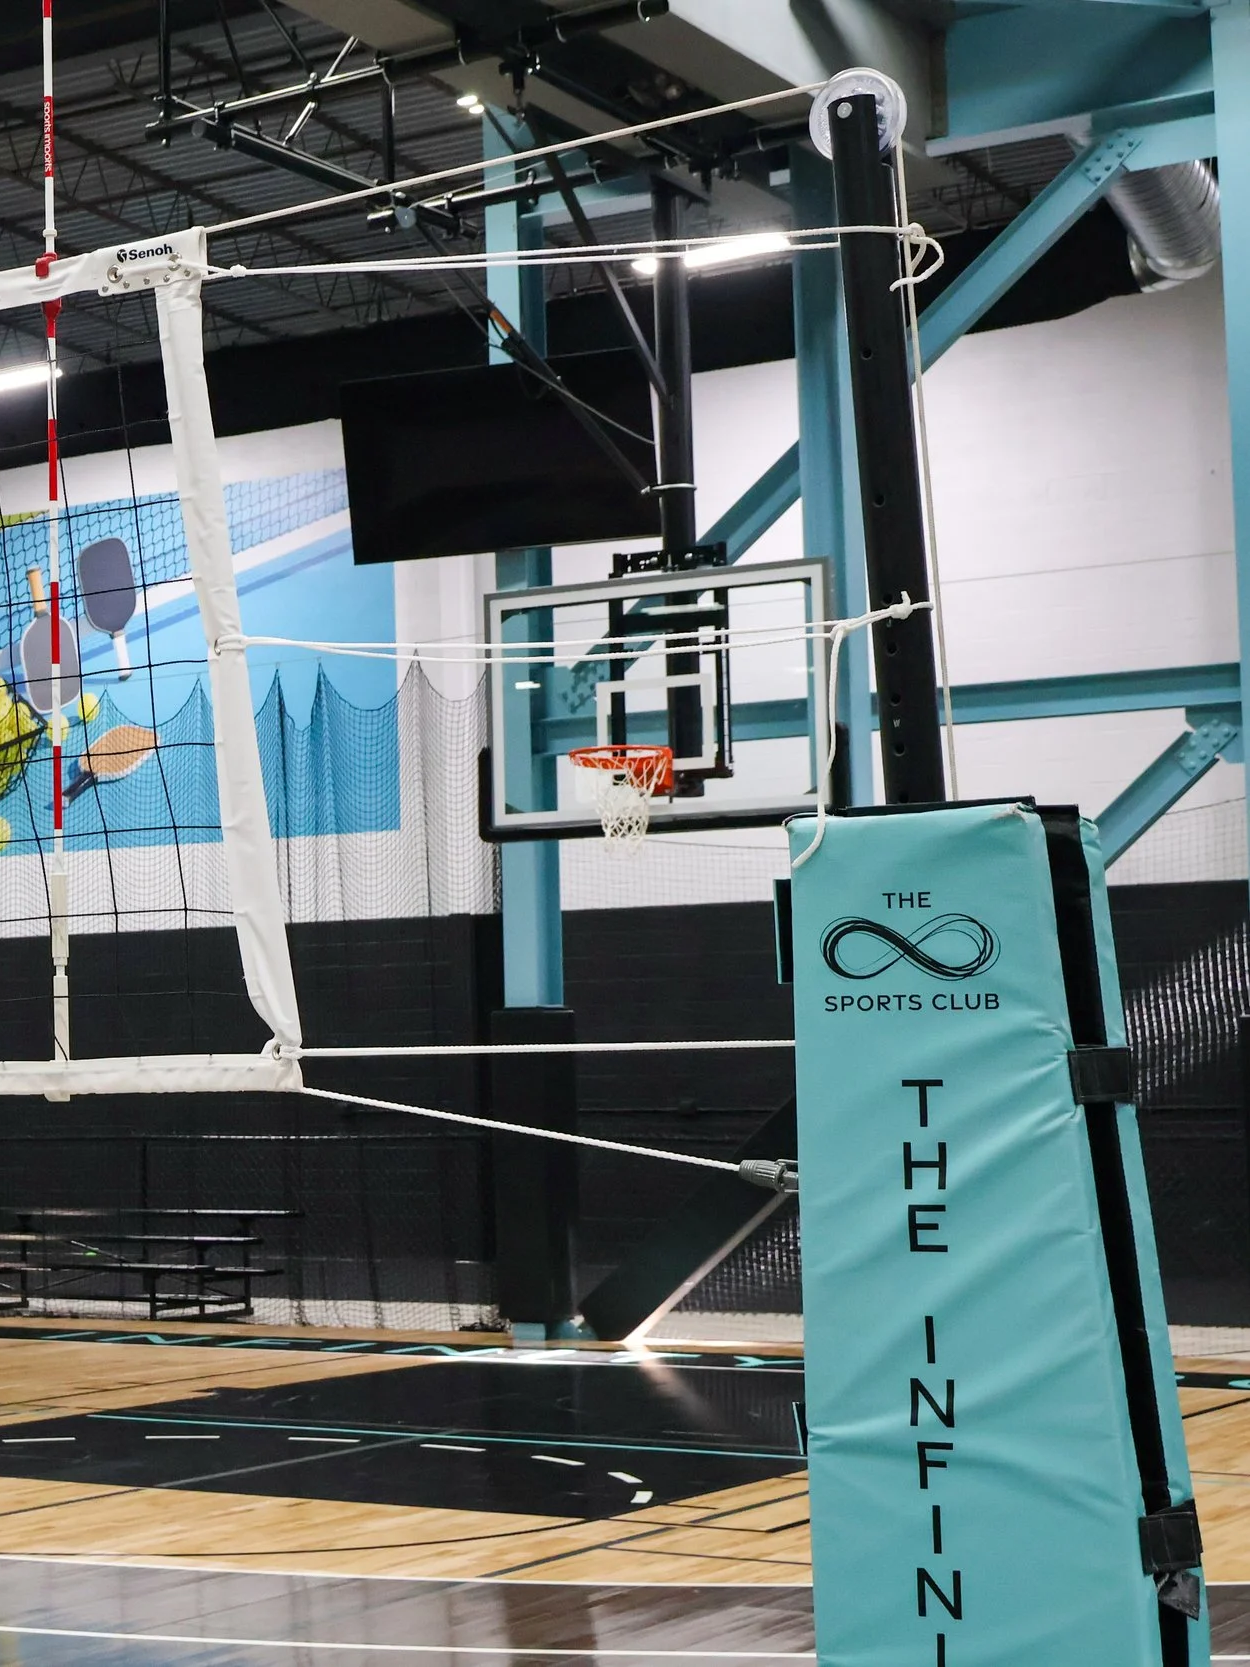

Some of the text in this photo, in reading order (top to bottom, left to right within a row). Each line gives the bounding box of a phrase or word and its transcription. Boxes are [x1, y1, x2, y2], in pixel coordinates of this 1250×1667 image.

[129, 243, 173, 260] Senoh
[882, 891, 931, 908] THE
[825, 993, 1000, 1012] SPORTS CLUB
[901, 1079, 948, 1252] THE
